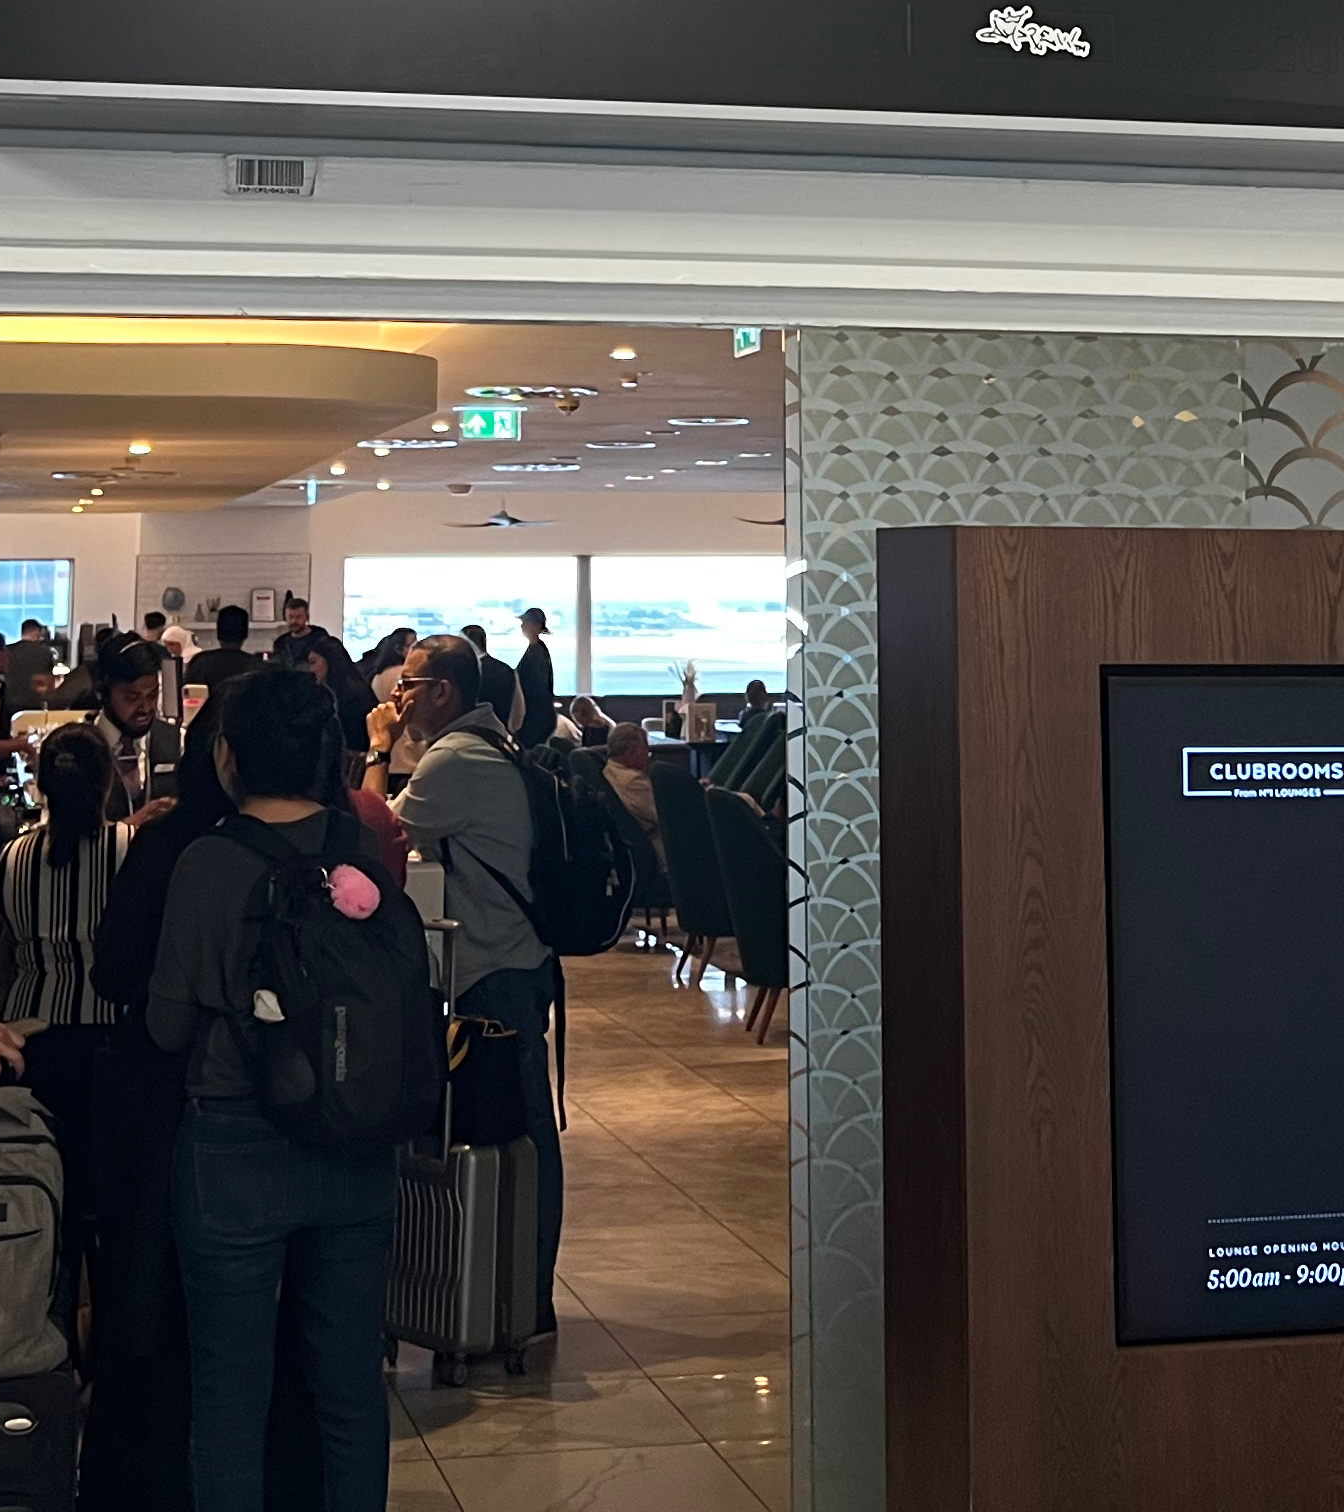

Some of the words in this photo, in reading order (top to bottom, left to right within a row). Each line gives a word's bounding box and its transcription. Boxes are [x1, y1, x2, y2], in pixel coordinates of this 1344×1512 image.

[1209, 762, 1344, 781] CLUBROOMS
[1233, 788, 1257, 798] From
[1274, 787, 1322, 798] LOUNGES
[335, 1005, 348, 1083] patagonia
[1208, 1245, 1258, 1258] LOUNGE
[1263, 1241, 1318, 1255] OPENING
[1206, 1267, 1281, 1290] 5:00am
